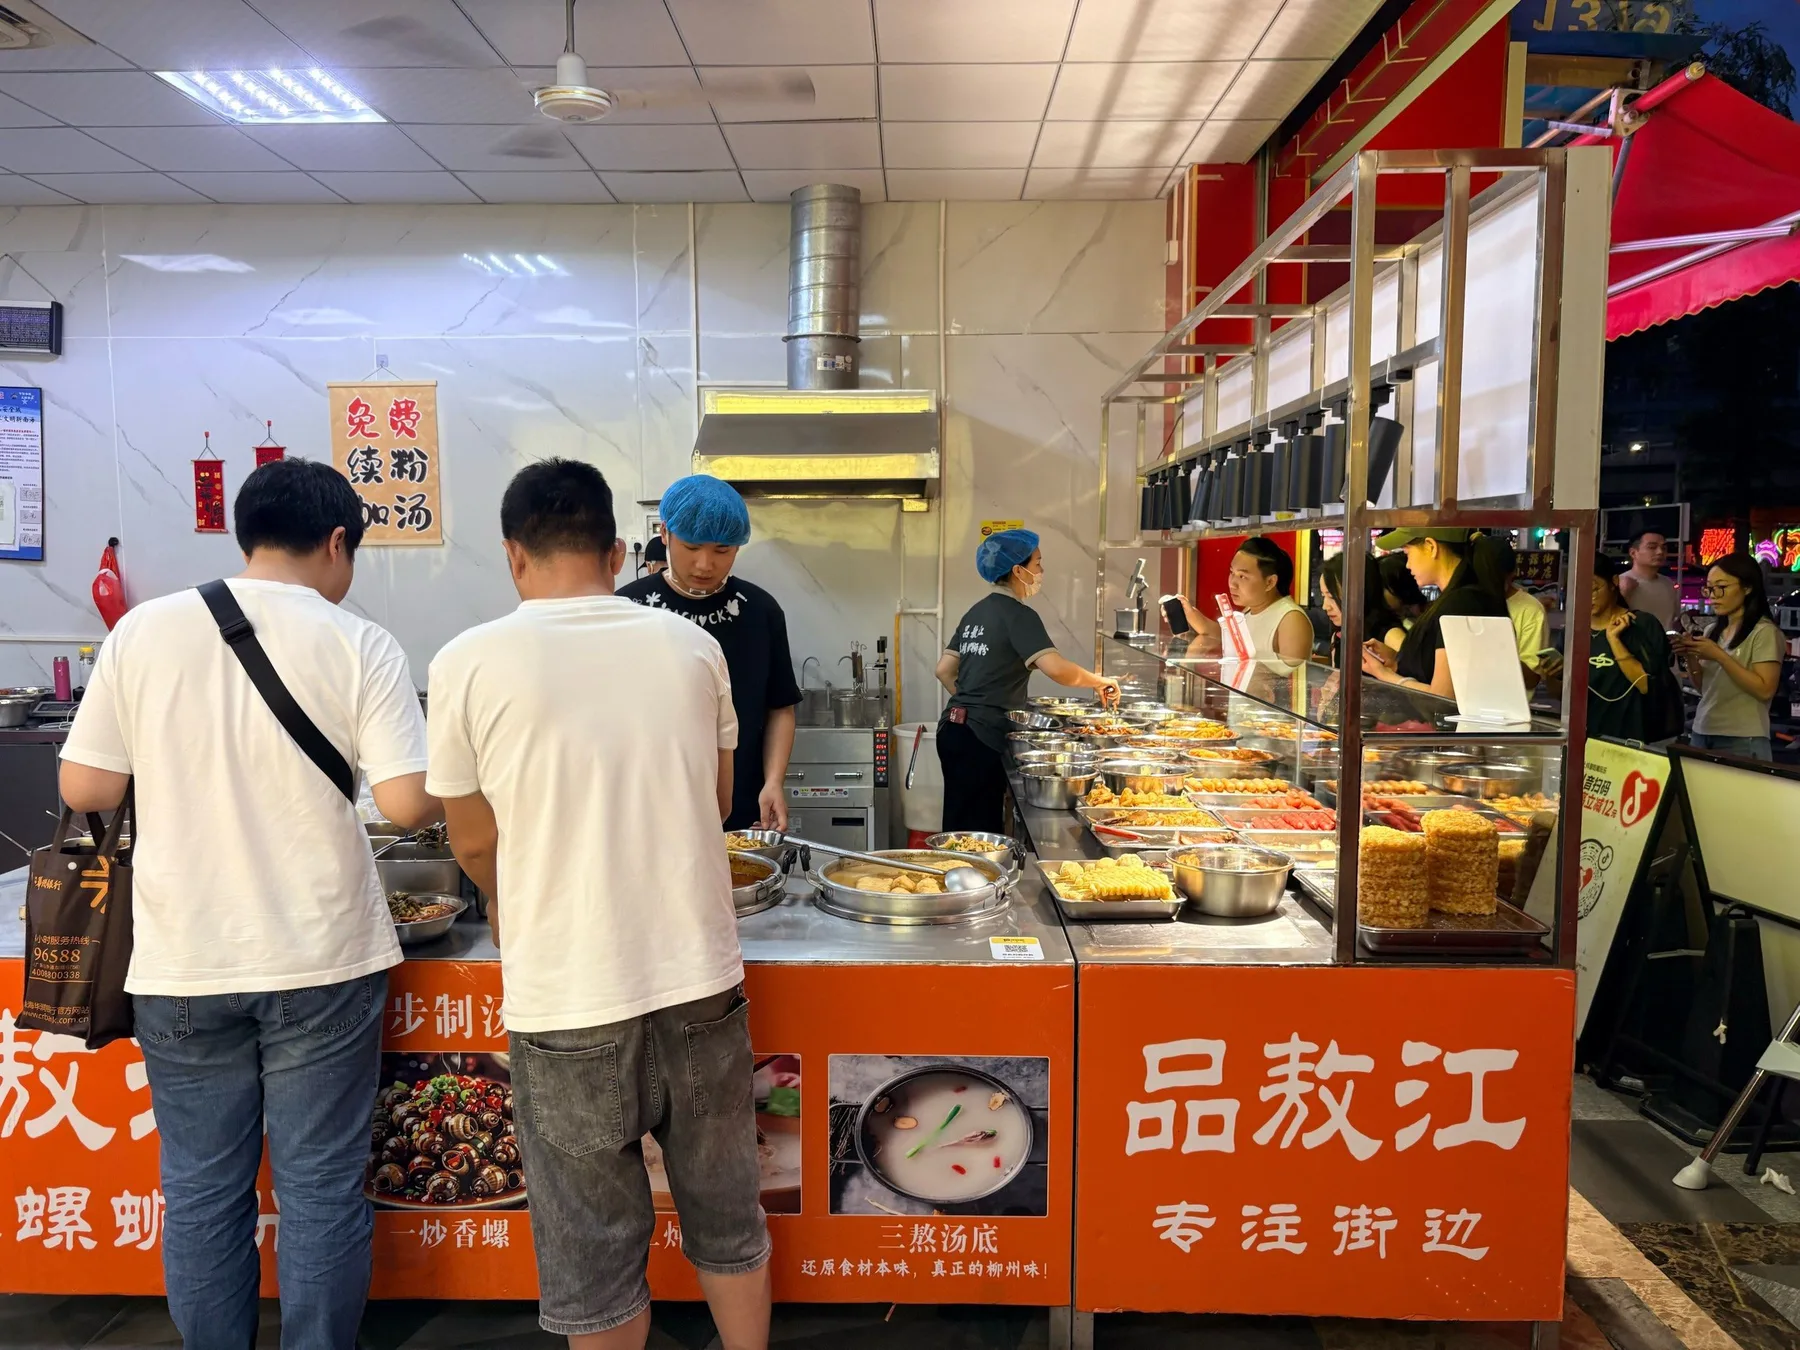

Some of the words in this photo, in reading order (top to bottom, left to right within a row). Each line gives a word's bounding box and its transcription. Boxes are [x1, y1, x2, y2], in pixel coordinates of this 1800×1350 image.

[348, 397, 420, 439] 免费
[347, 446, 428, 483] 续粉
[34, 947, 81, 964] 96588
[31, 968, 81, 979] 4008800338
[1125, 1032, 1526, 1161] 品敖江
[390, 1218, 510, 1249] 一炒香螺
[878, 1223, 999, 1254] 三熬汤底
[1152, 1200, 1490, 1261] 专注街边
